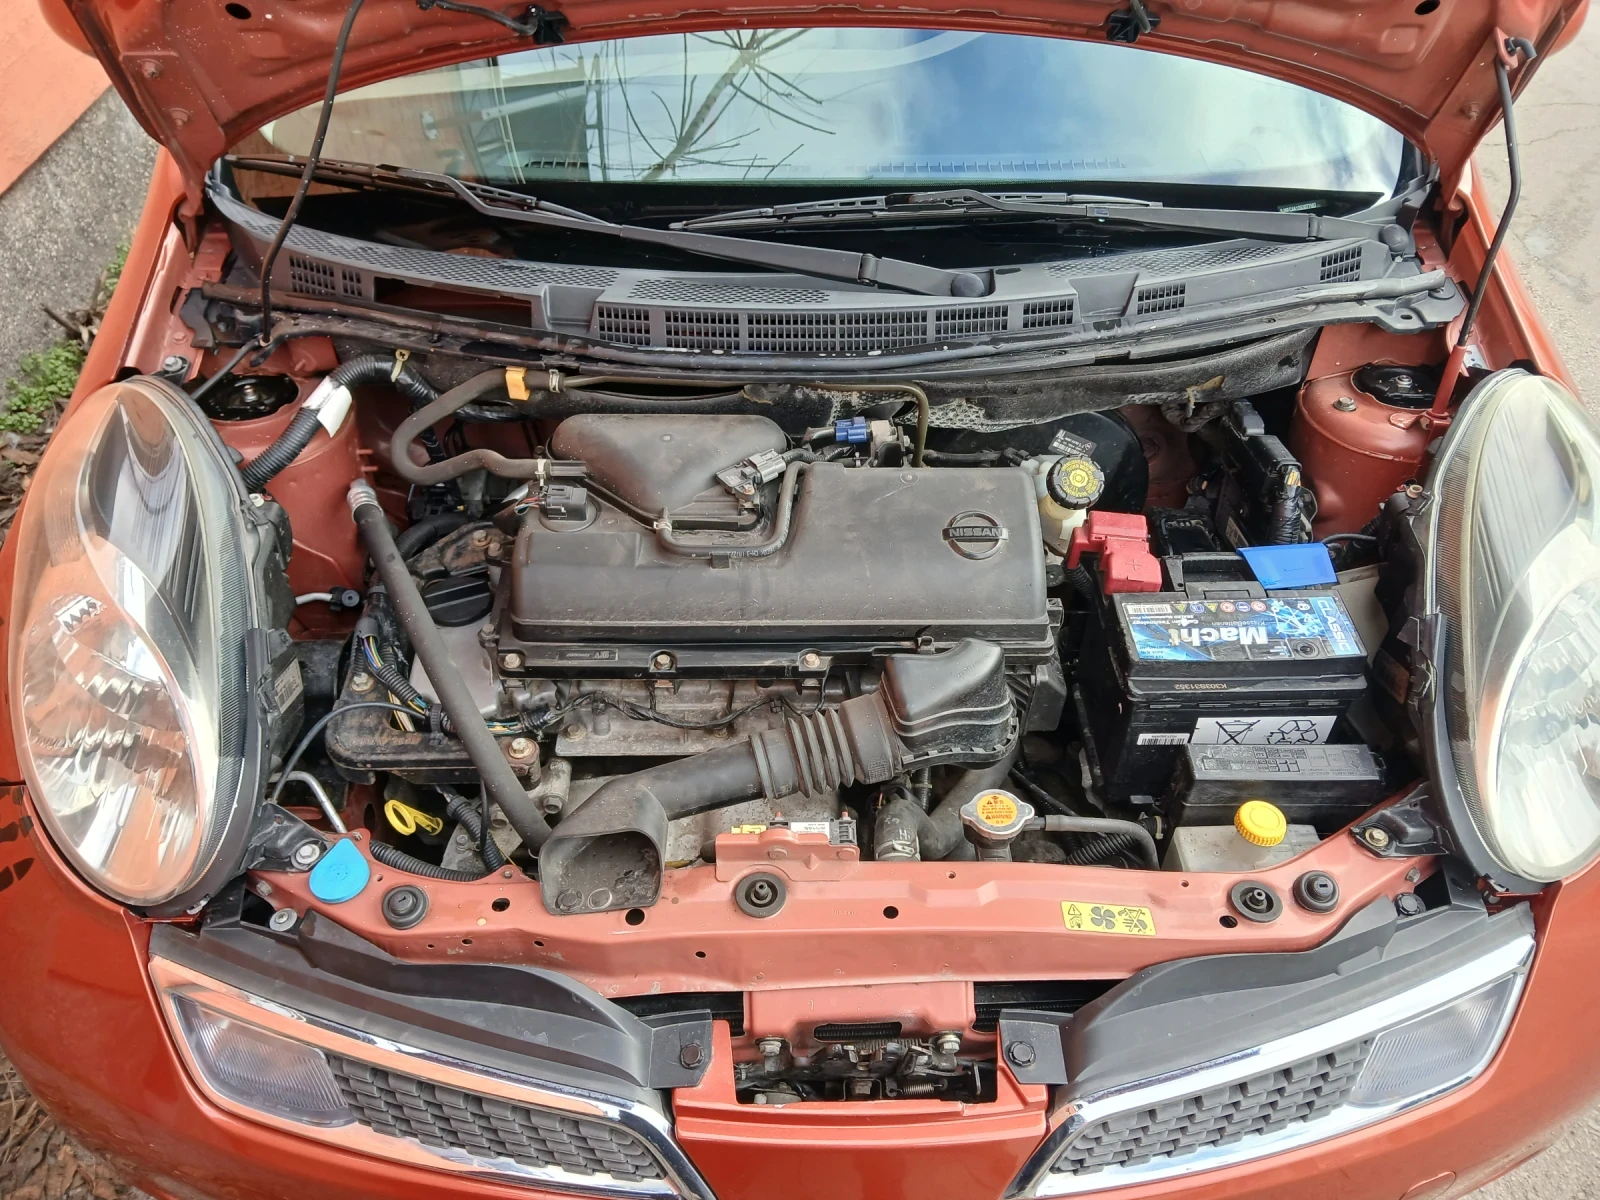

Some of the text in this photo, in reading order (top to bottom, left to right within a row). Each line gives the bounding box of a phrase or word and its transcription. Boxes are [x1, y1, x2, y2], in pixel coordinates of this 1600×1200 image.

[949, 527, 1001, 537] NISSAN
[1317, 599, 1351, 652] CLASSIC
[1169, 627, 1267, 647] Macht
